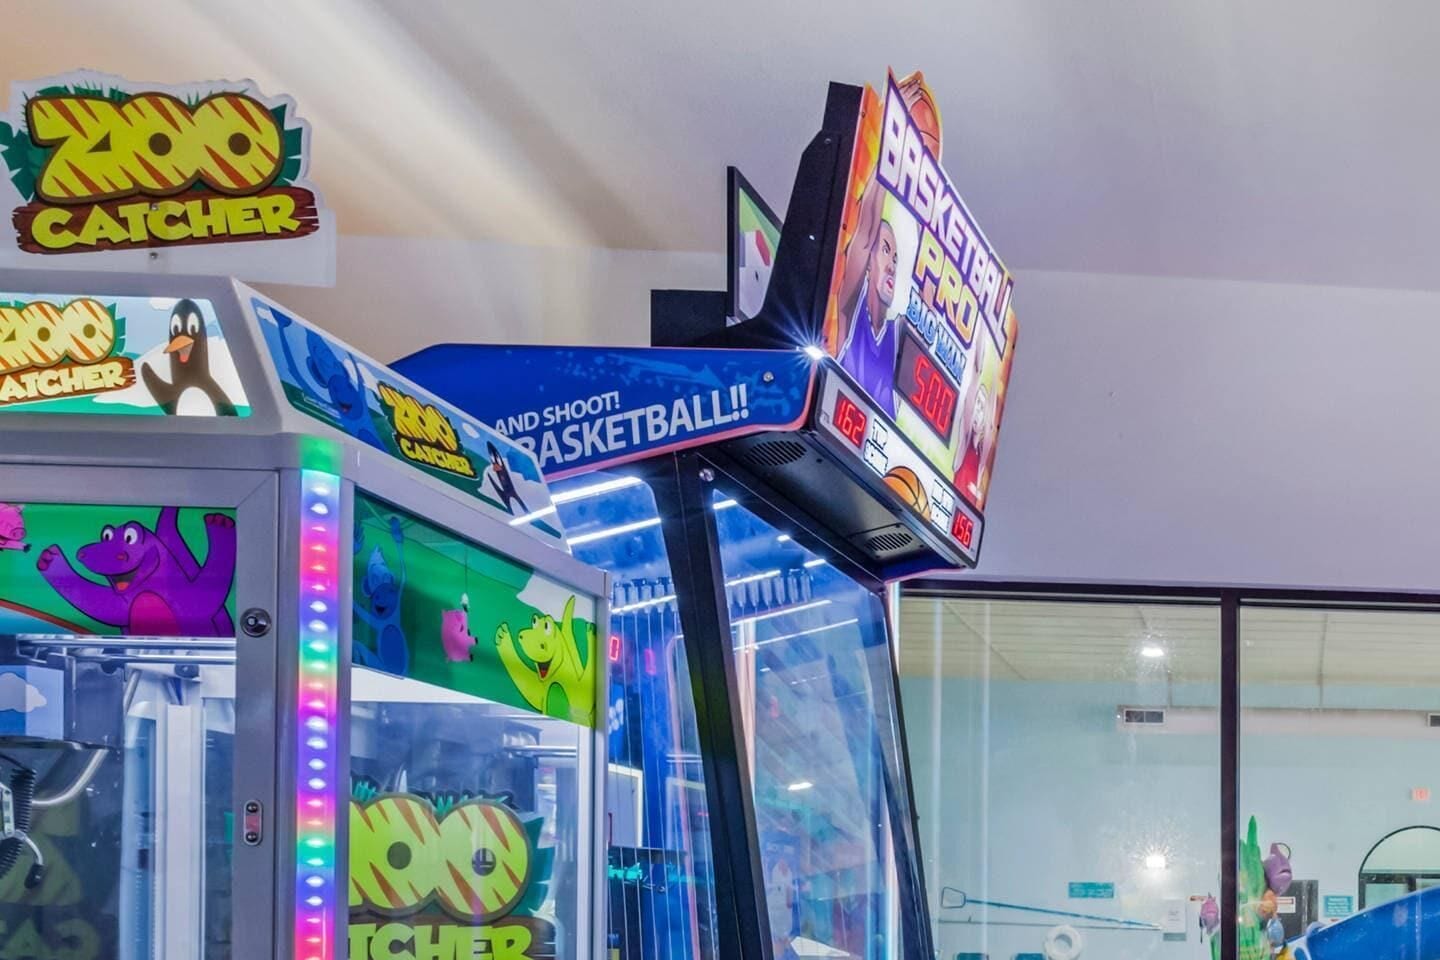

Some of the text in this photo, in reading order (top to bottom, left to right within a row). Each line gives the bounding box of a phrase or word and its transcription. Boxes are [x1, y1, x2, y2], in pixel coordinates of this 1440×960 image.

[26, 92, 285, 203] ZOO
[31, 194, 301, 249] CATCHER
[877, 86, 1014, 357] BASKETBALL
[914, 226, 979, 346] PRO
[0, 362, 125, 402] ATCHER
[378, 383, 459, 452] ZOO
[495, 390, 621, 437] AND SHOOT!
[912, 353, 957, 433] 500
[836, 401, 867, 445] 162
[349, 797, 529, 916] OO
